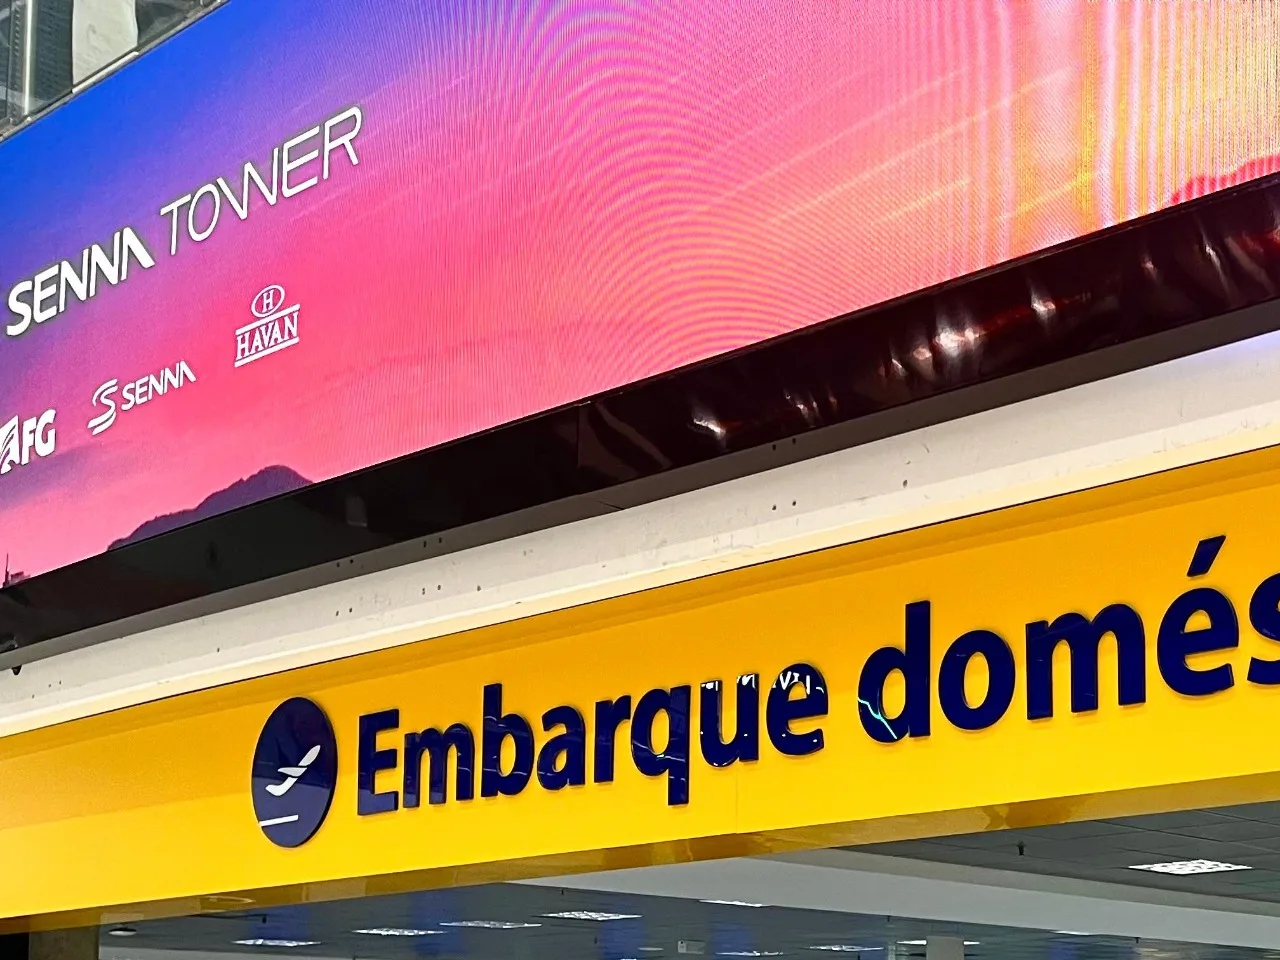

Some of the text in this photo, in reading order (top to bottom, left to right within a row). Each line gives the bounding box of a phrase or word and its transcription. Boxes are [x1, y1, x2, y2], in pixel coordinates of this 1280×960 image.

[6, 105, 363, 337] SENNA TOWER
[236, 308, 299, 362] HAVAN
[121, 360, 197, 411] SENNA
[357, 662, 829, 806] Embarque
